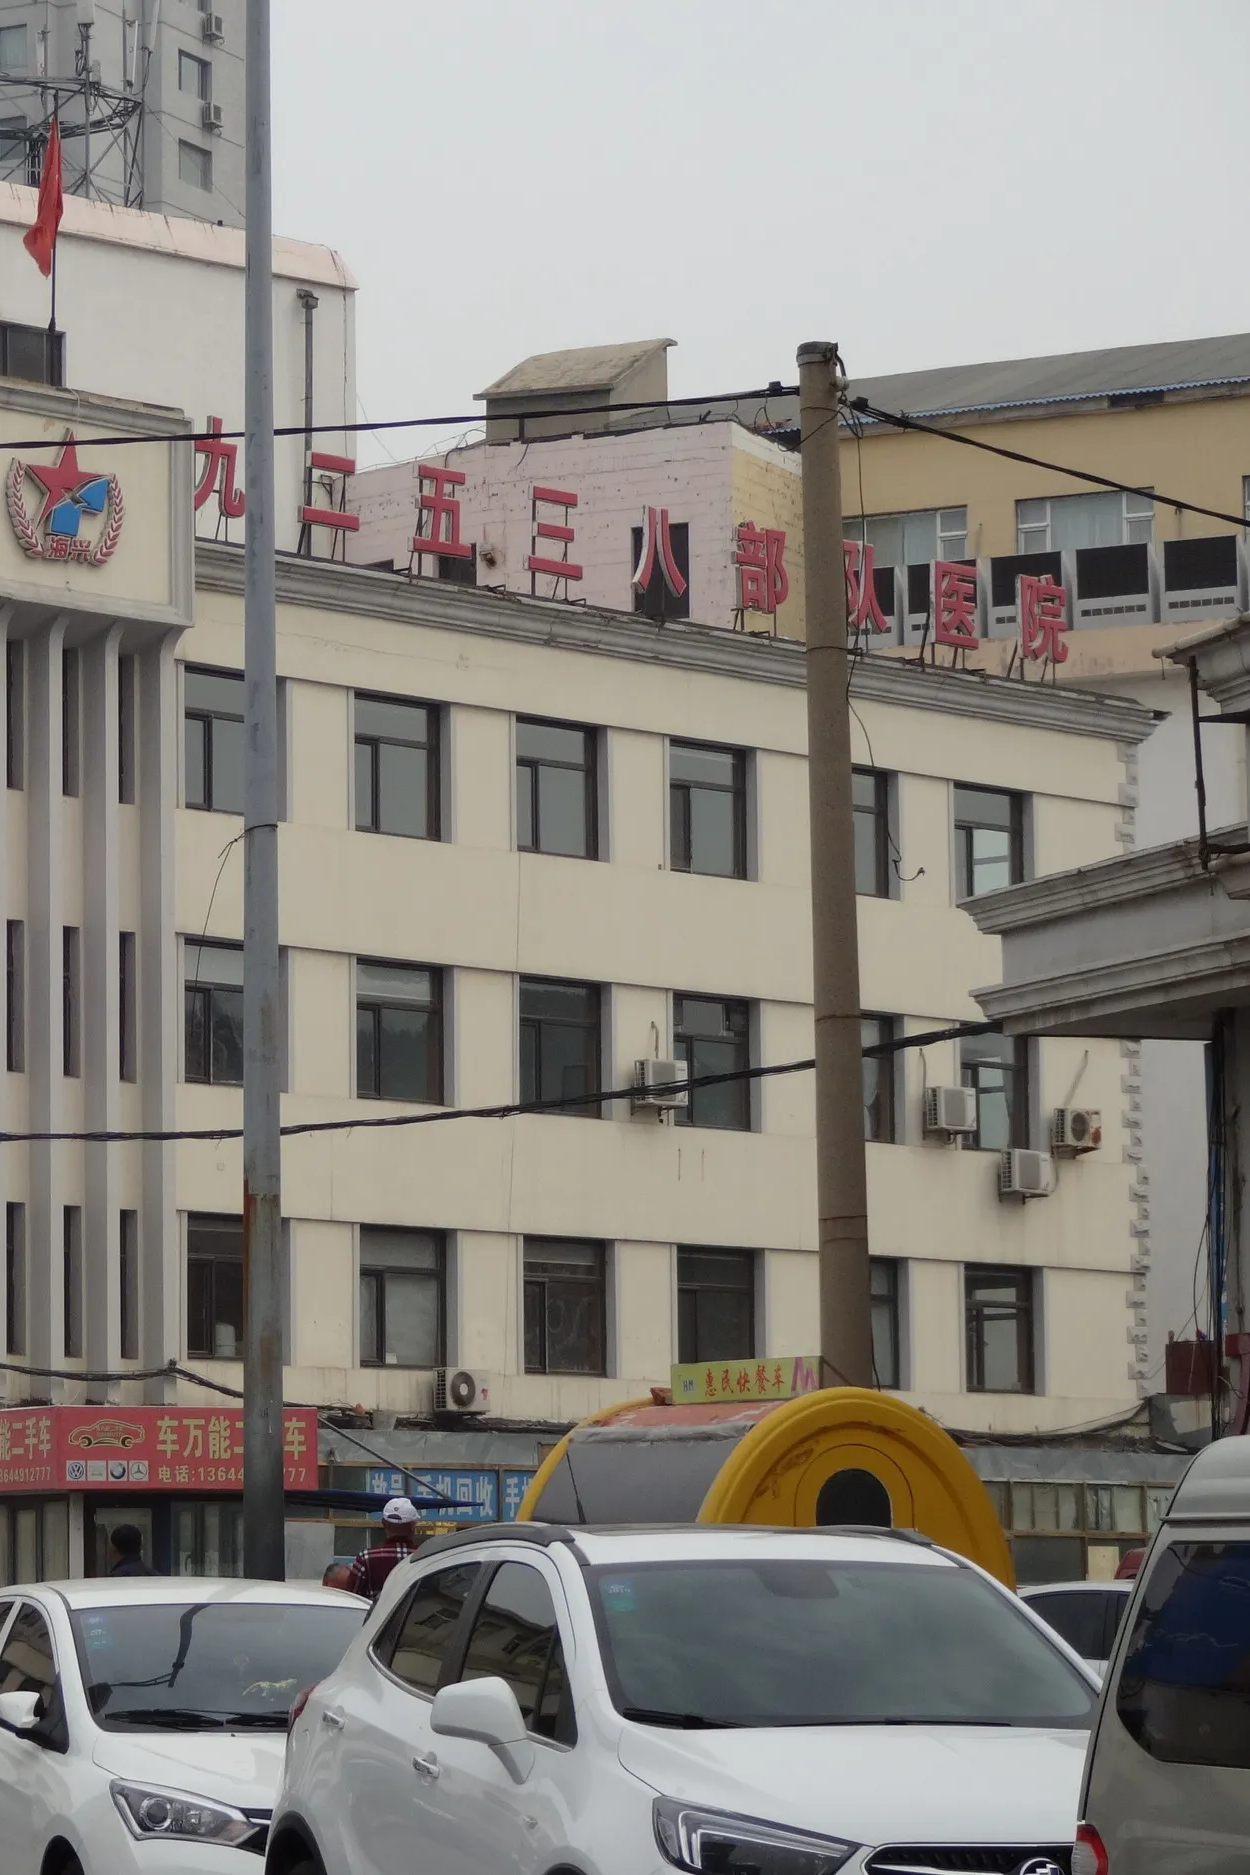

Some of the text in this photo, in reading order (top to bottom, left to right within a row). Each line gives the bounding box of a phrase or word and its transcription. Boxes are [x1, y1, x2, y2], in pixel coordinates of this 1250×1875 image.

[195, 416, 1068, 664] 九二五三八部队医院
